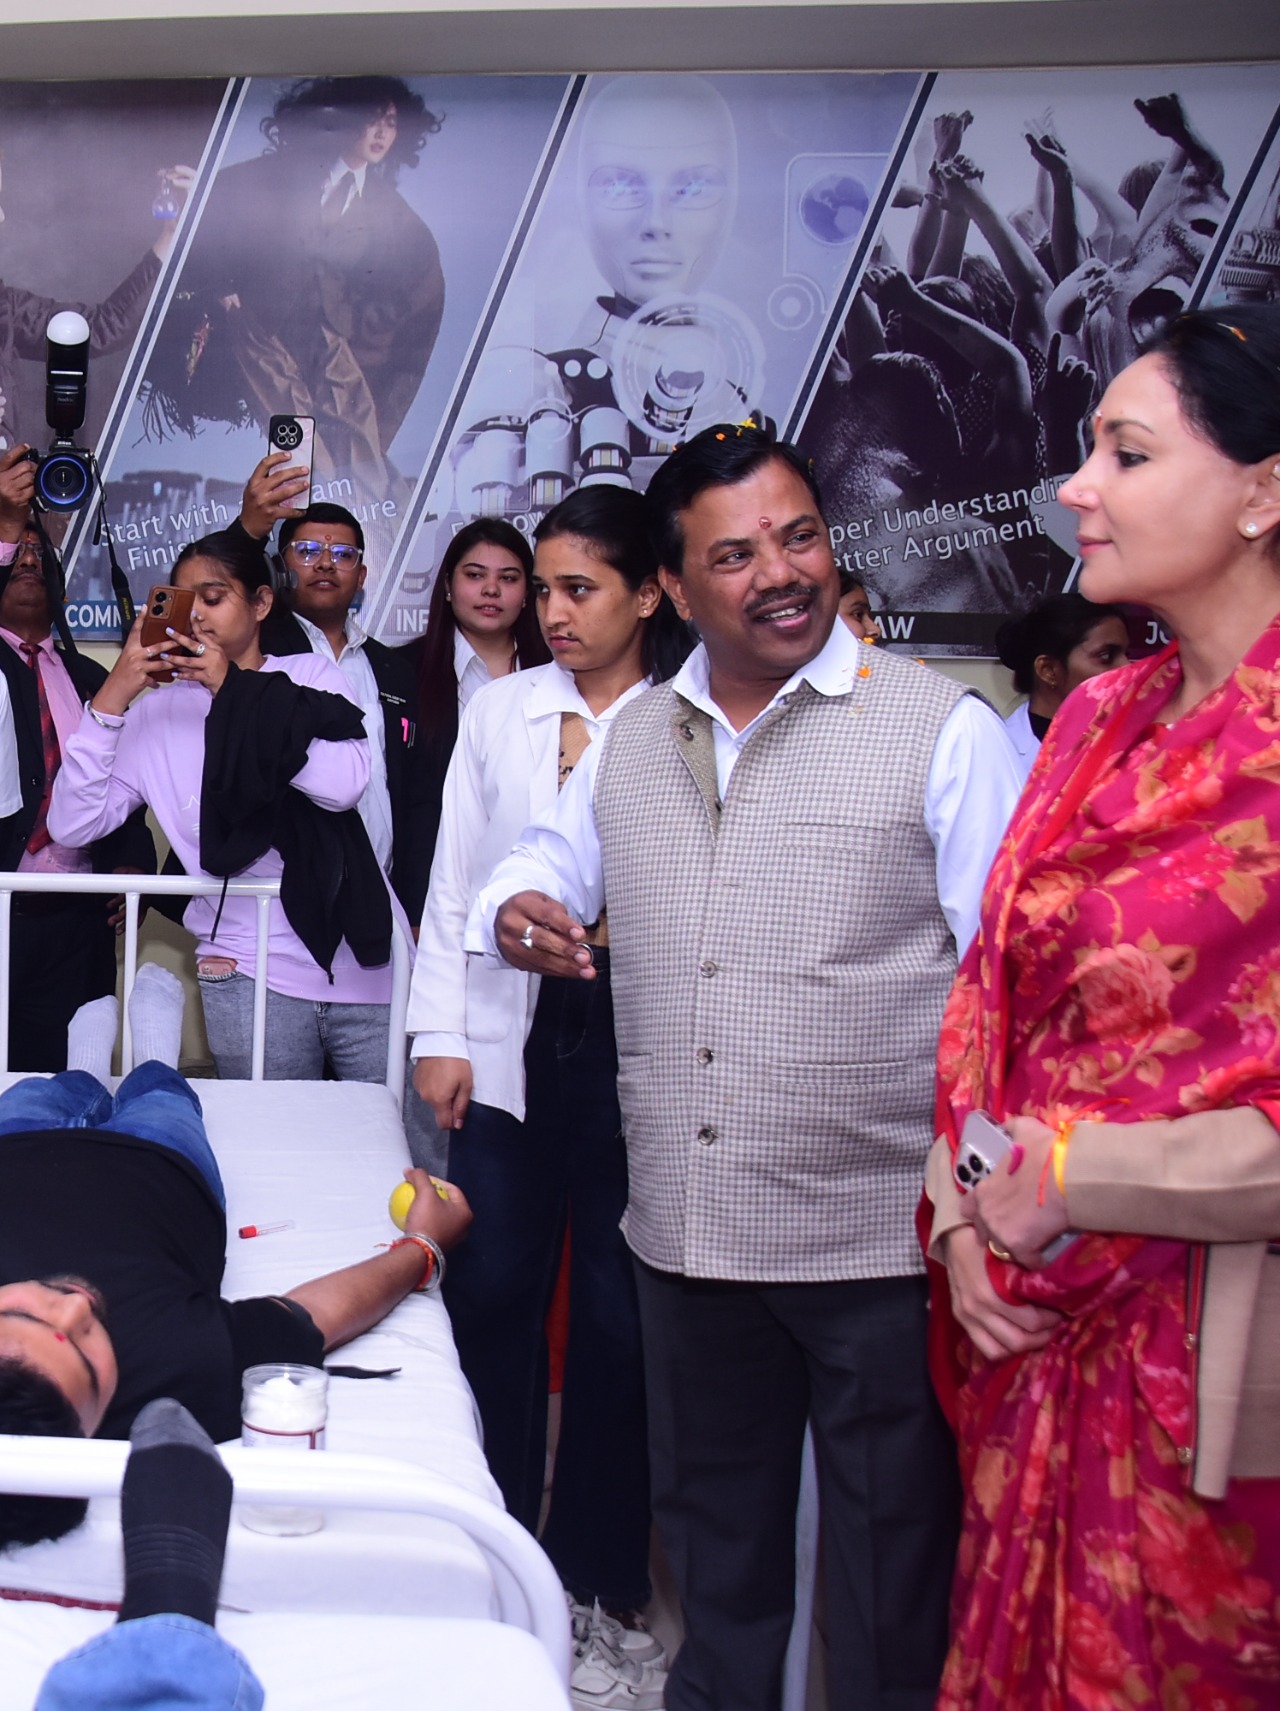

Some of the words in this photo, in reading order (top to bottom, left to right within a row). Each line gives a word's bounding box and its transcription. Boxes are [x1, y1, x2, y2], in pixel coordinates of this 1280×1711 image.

[99, 514, 163, 548] Start
[170, 499, 228, 532] with
[312, 477, 353, 503] am
[128, 540, 195, 571] Finis
[360, 499, 398, 523] ure
[829, 517, 874, 550] per
[834, 544, 893, 573] etter
[903, 513, 1046, 561] Argument
[396, 608, 430, 633] INF
[873, 615, 915, 640] AW
